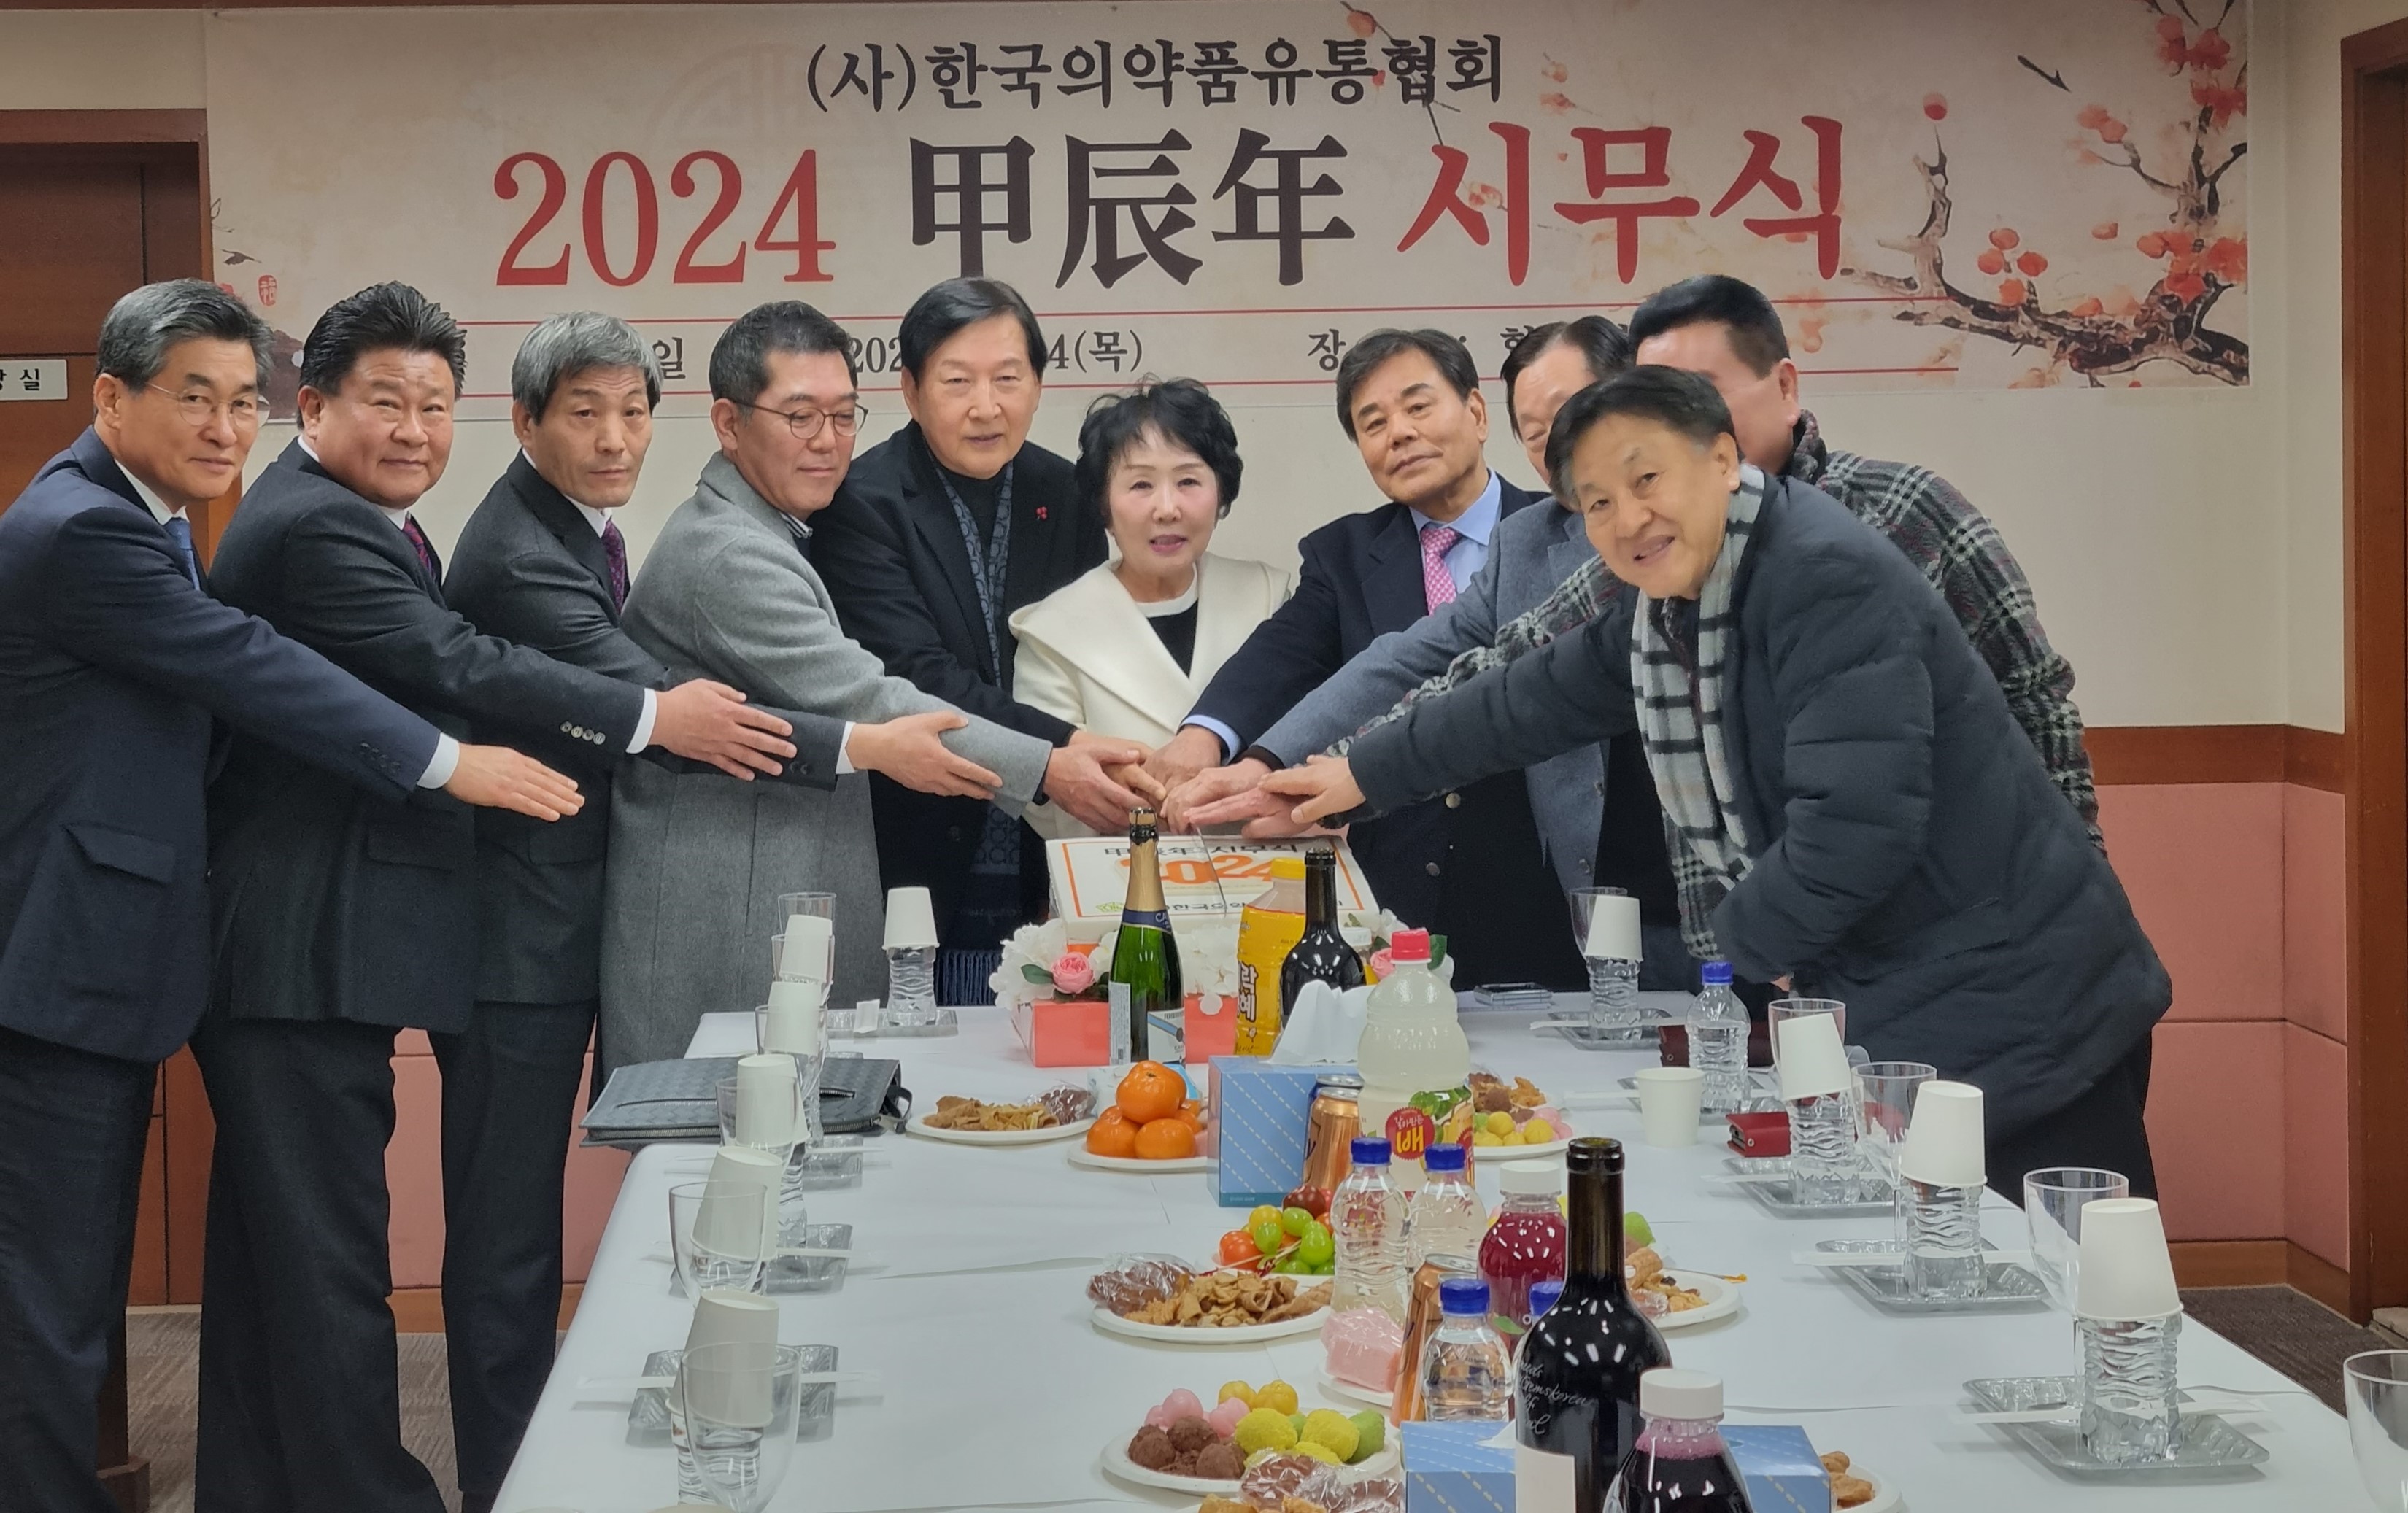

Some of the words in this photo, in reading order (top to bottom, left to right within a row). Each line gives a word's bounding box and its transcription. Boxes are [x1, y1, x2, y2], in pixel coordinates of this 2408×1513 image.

[808, 34, 1501, 112] (사)한국의약품유통협회
[494, 150, 836, 286] 2024
[910, 128, 1355, 289] 甲辰年
[1397, 115, 1843, 286] 시무식
[846, 337, 902, 373] 202
[1396, 1126, 1424, 1154] 배
